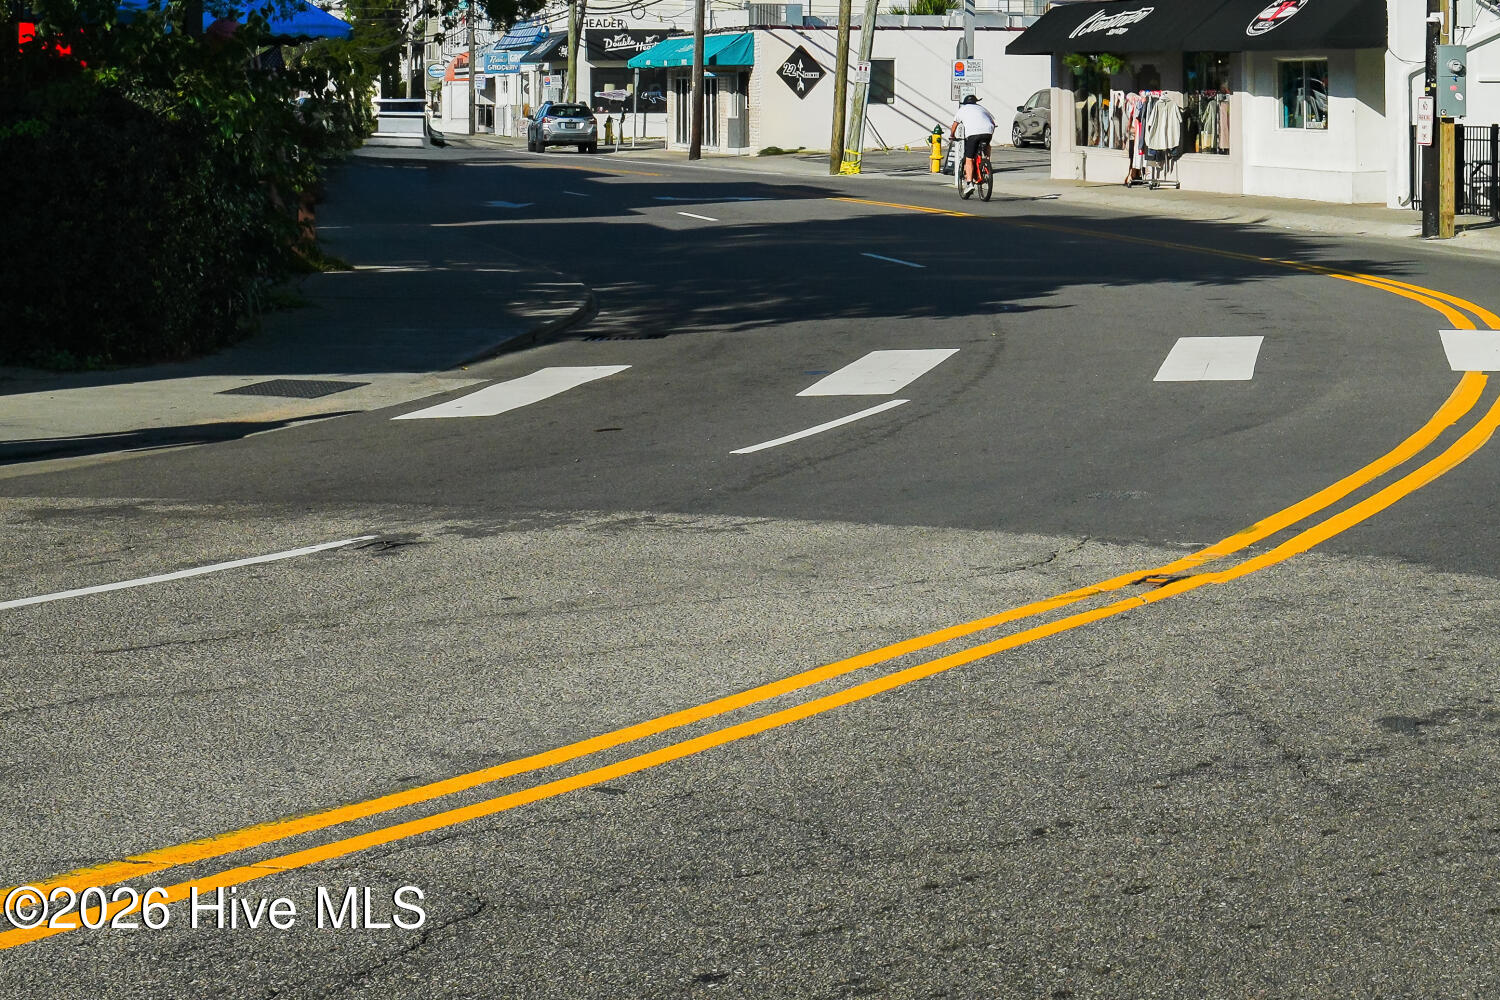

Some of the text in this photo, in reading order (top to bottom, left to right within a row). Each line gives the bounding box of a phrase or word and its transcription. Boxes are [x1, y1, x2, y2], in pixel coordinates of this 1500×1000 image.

[582, 18, 624, 28] HEADER
[603, 36, 635, 49] Double
[783, 62, 796, 77] 22
